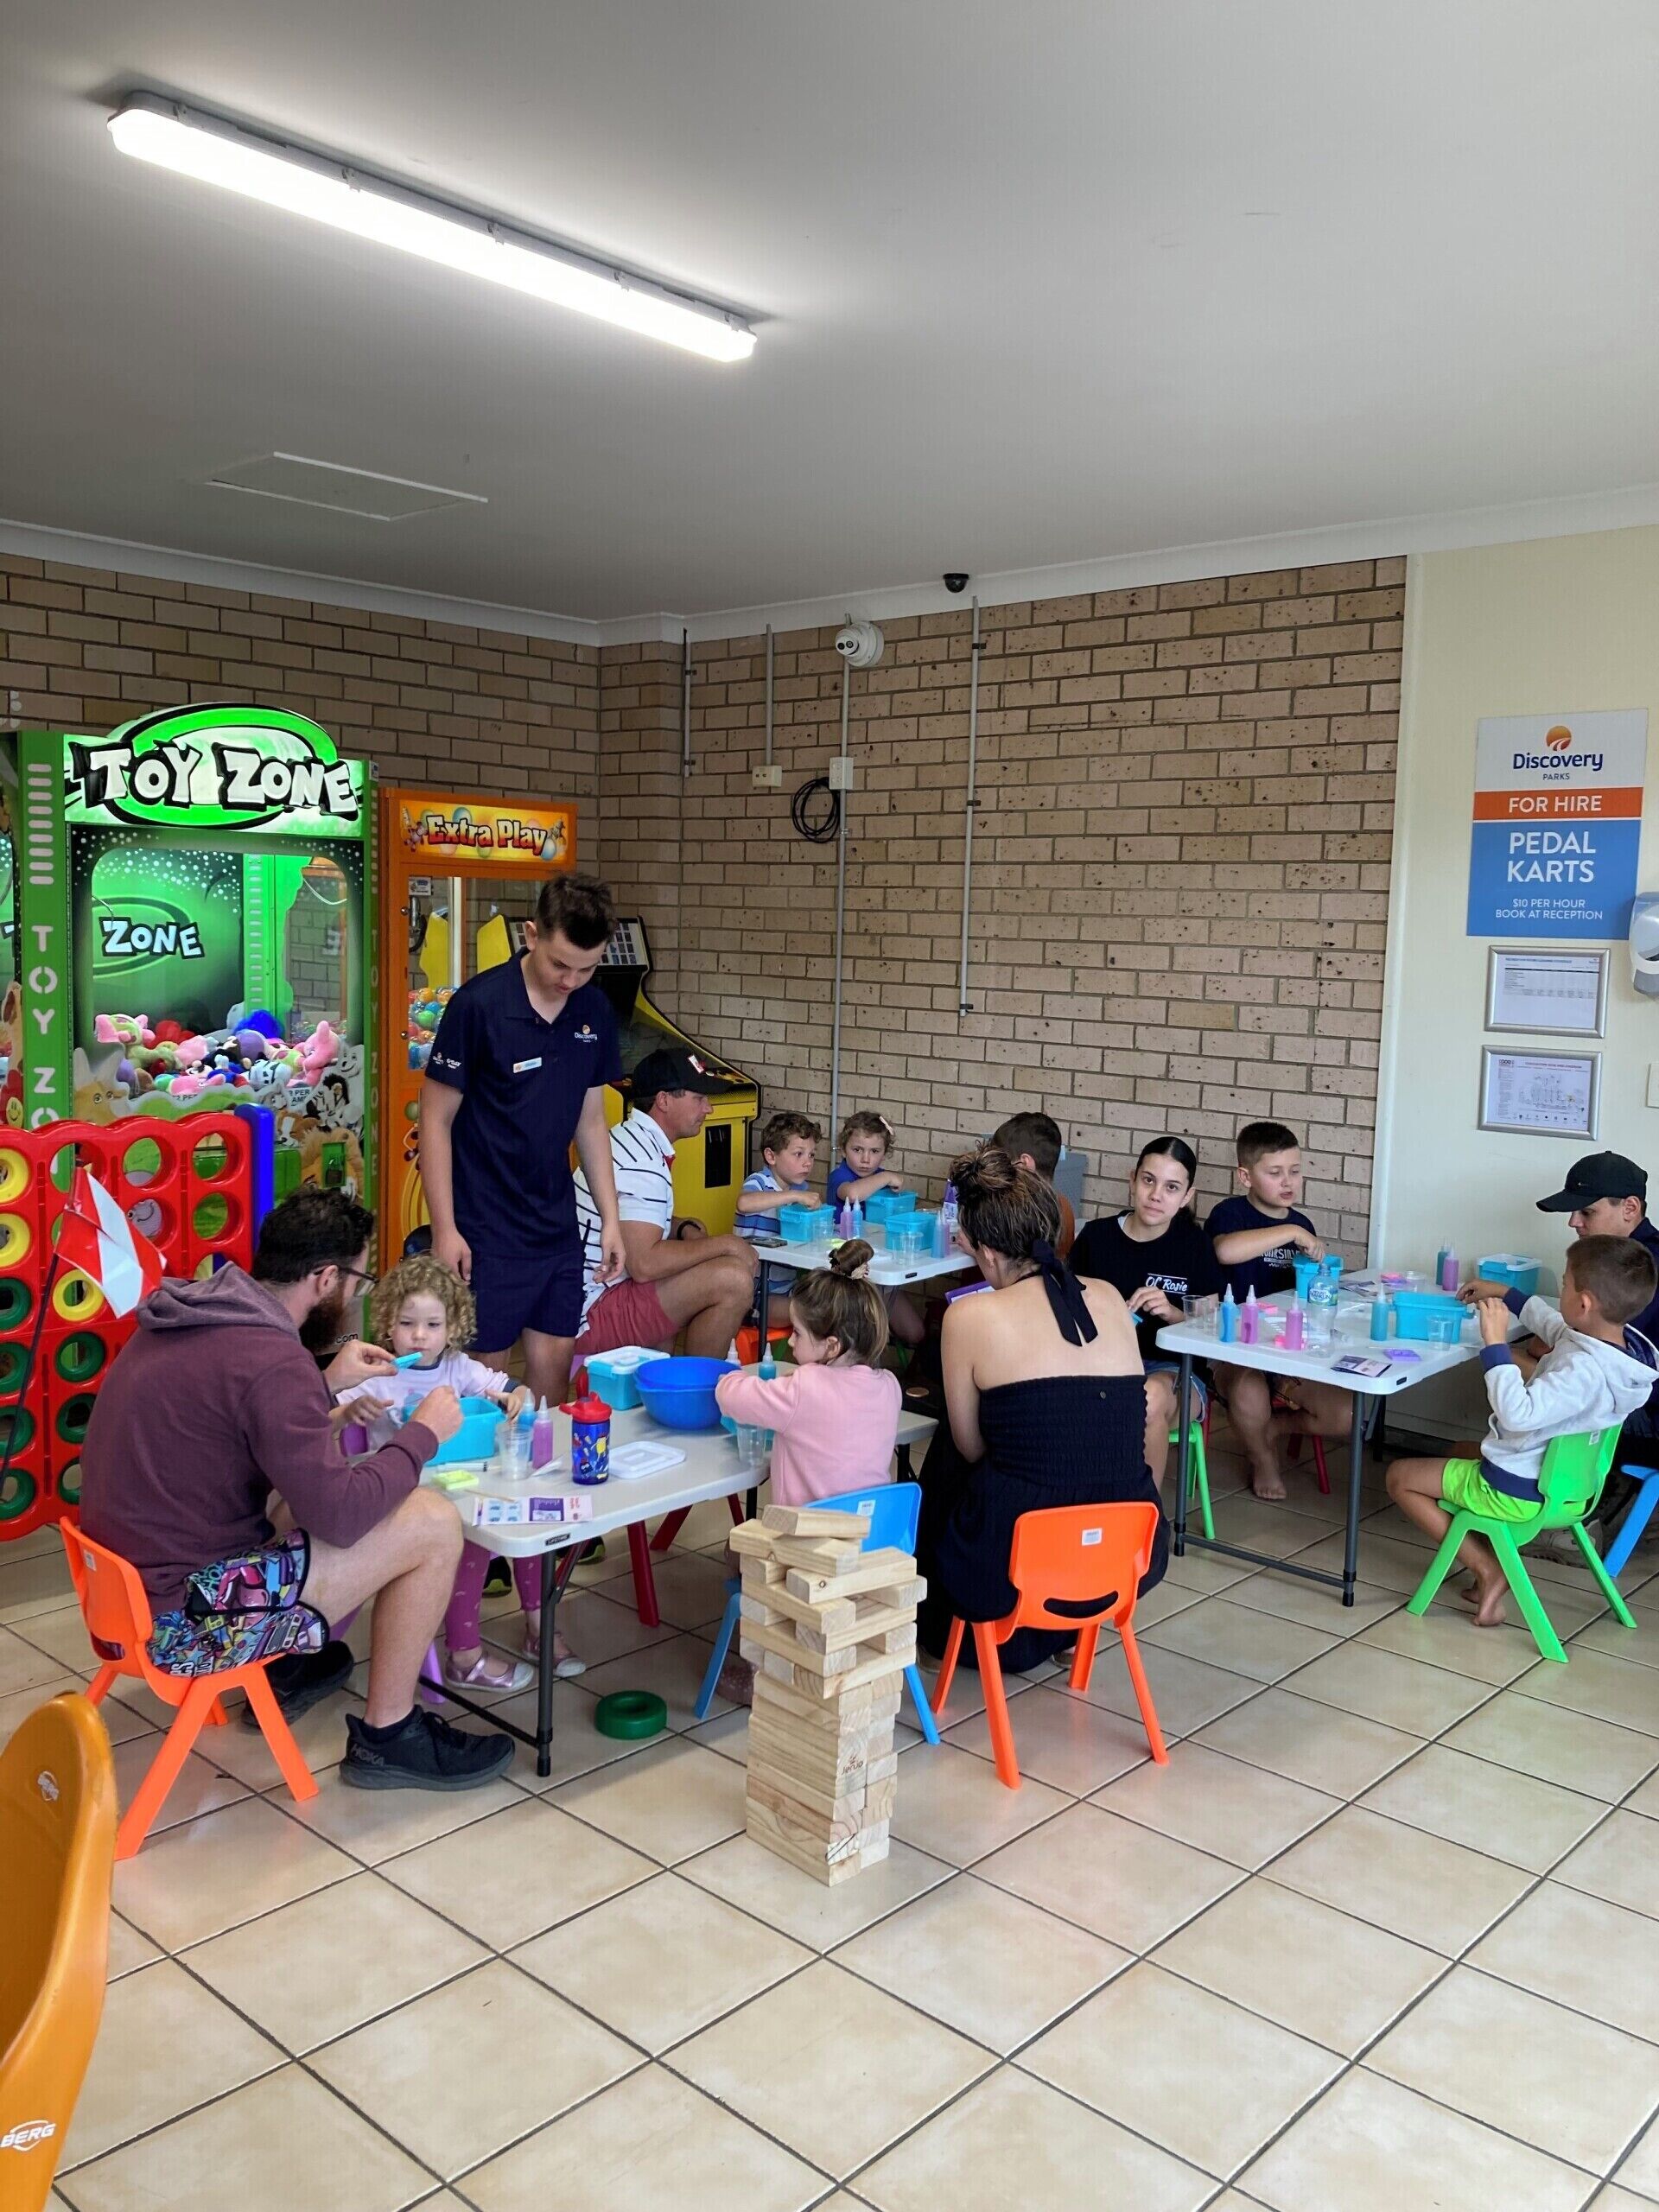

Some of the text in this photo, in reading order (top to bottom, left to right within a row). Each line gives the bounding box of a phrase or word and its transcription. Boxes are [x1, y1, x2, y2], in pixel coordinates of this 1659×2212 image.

[1513, 753, 1603, 772] Discovery
[88, 744, 359, 814] TOY ZONE
[1542, 772, 1571, 781] PARKS
[1509, 795, 1603, 813] FOR HIRE
[426, 815, 548, 855] Extra Play
[1509, 830, 1597, 855] PEDAL
[1507, 860, 1595, 883] KARTS
[1495, 909, 1604, 920] BOOK AT RECEPTION
[1512, 898, 1586, 909] $10 PER HOUR
[101, 918, 203, 957] ZONE
[29, 925, 59, 1035] TOY
[1162, 1278, 1188, 1292] Rosie
[0, 2123, 56, 2148] BERG
